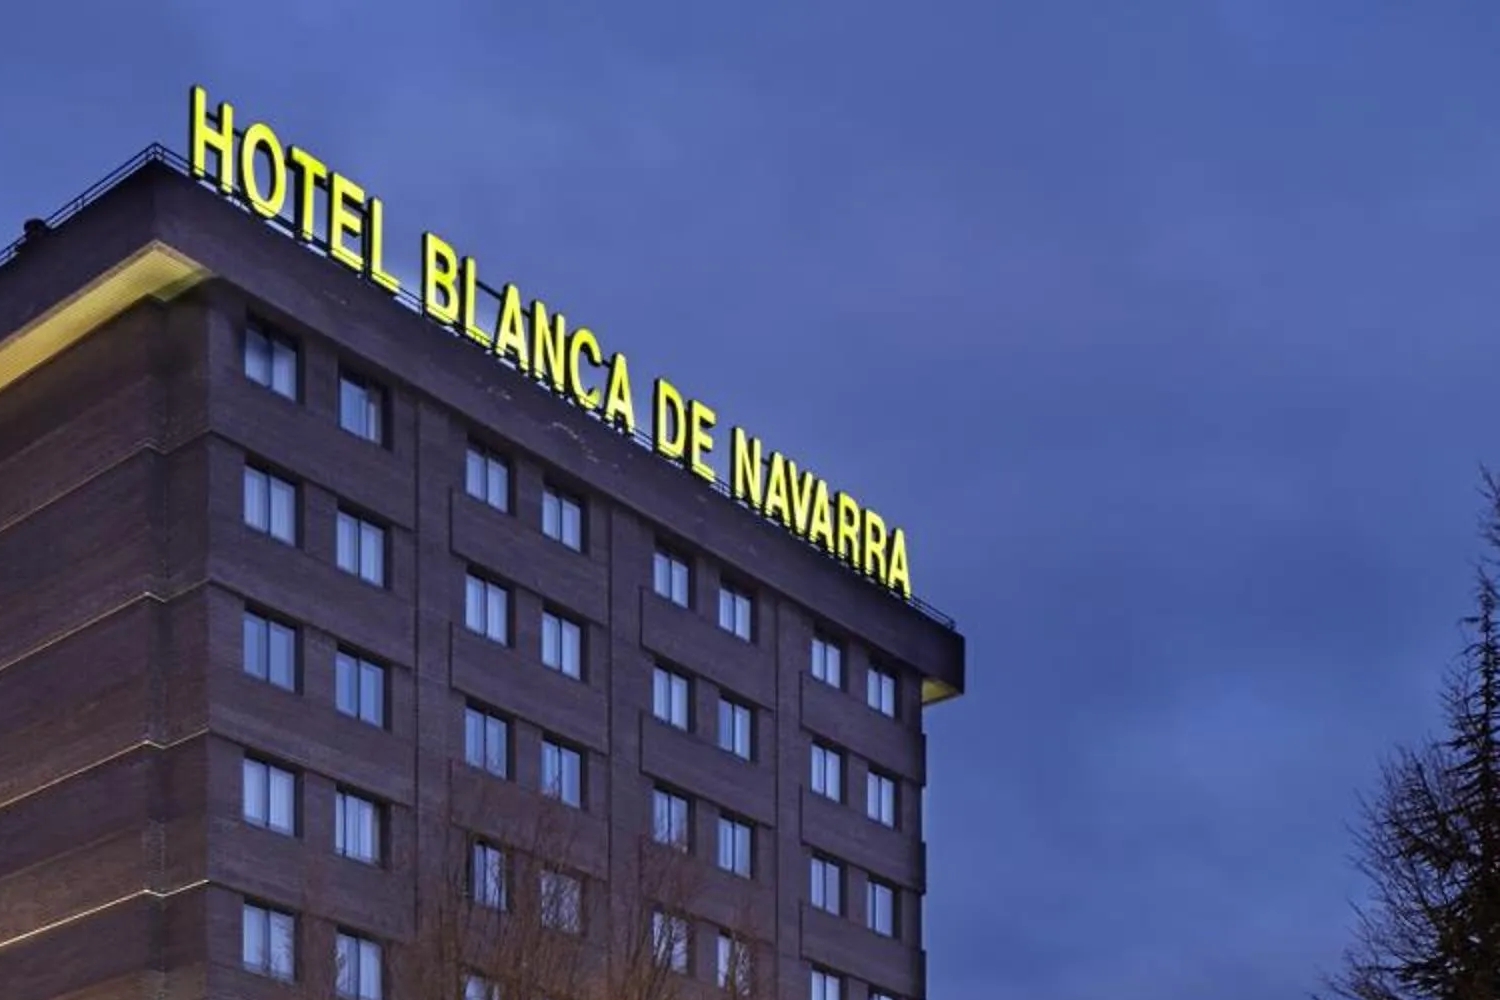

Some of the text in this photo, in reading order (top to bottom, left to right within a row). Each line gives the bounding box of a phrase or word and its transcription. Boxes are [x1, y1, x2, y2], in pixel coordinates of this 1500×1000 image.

[189, 84, 912, 596] HOTEL BLANCA DE NAVARRA
